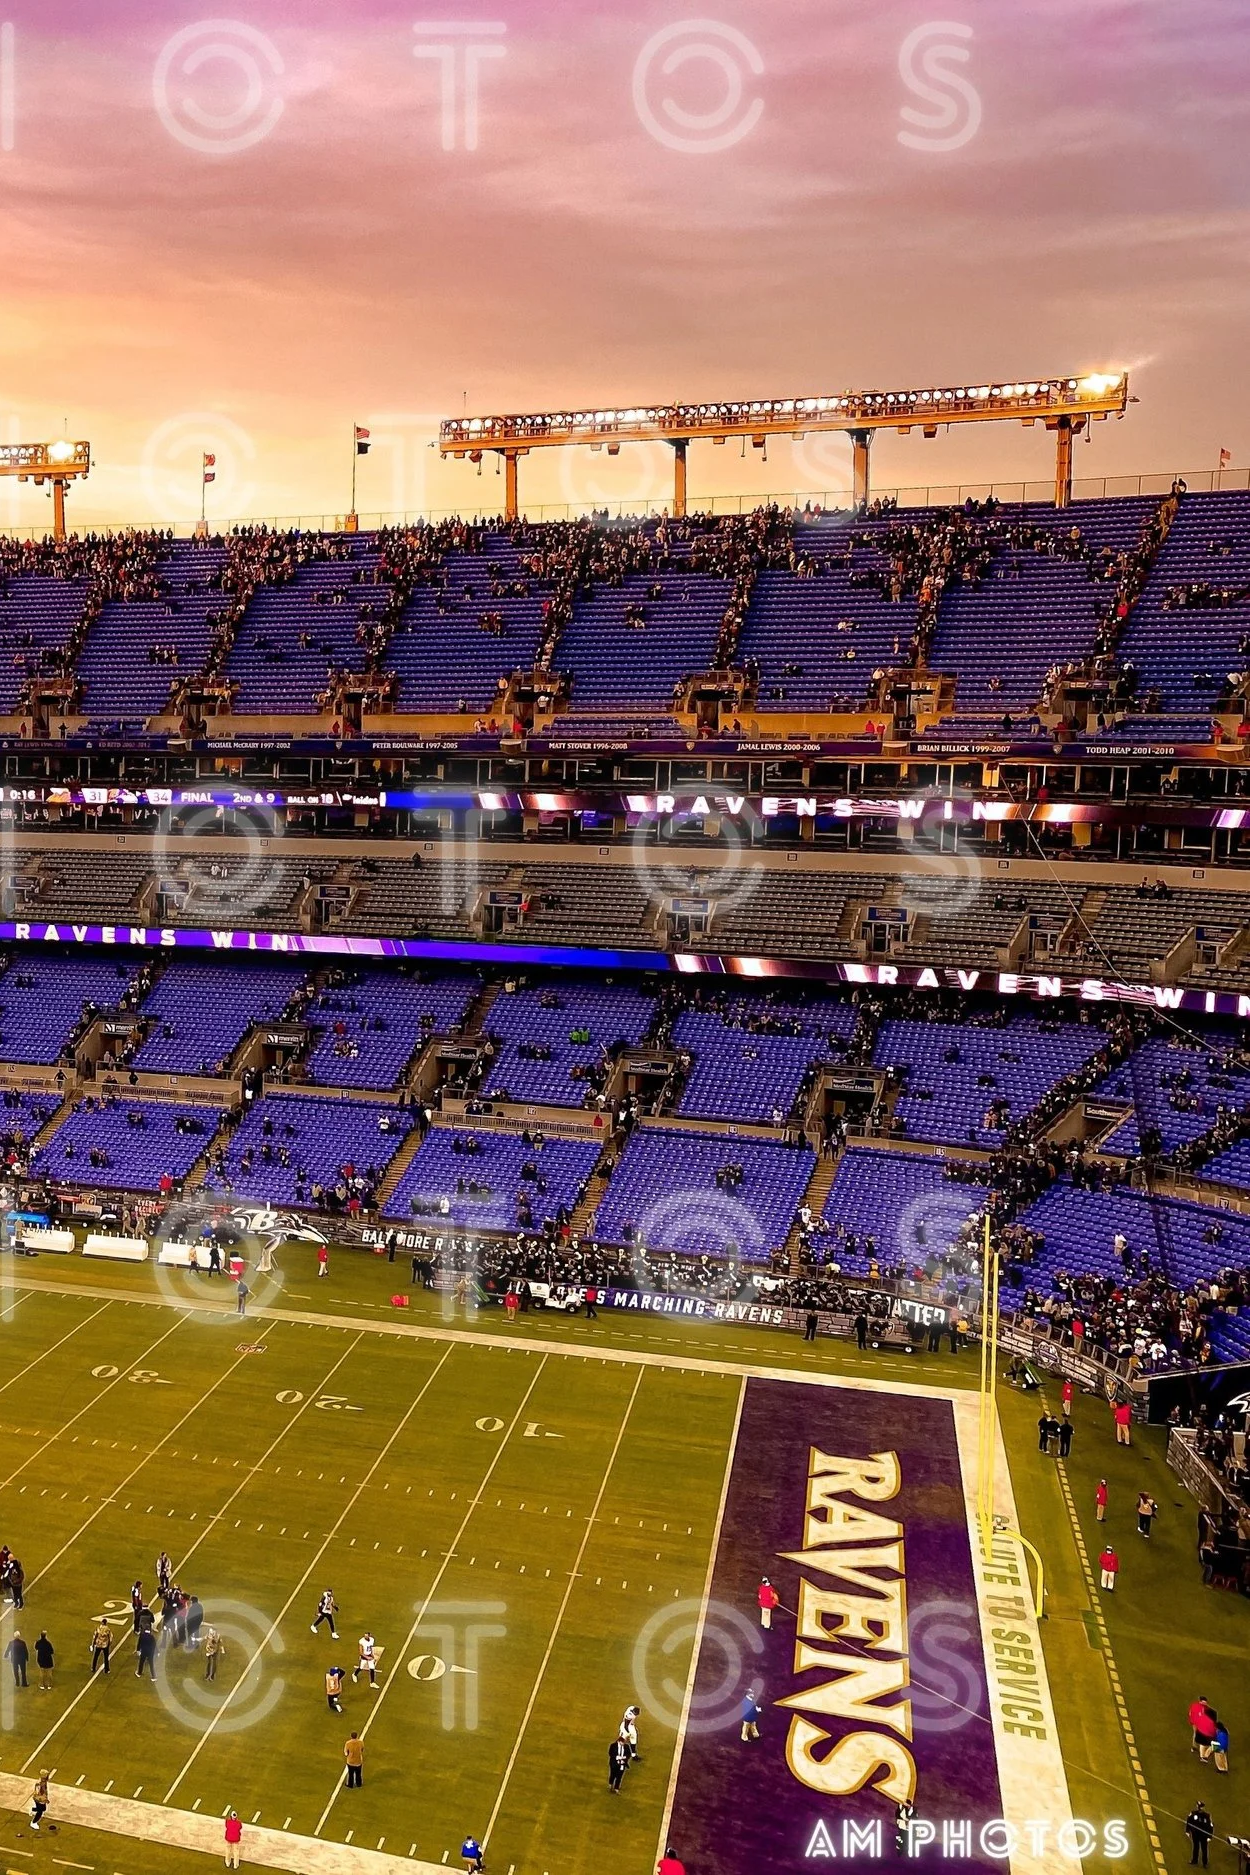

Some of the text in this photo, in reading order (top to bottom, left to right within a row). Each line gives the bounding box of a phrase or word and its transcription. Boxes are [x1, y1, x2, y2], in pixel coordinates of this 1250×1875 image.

[549, 742, 566, 750] MATT
[567, 742, 591, 750] STOVER
[737, 742, 759, 751] JAMAL
[760, 743, 781, 751] LEWIS
[917, 744, 1011, 753] BRIAN BILLICK 1999-2007
[1086, 746, 1108, 754] TODD
[1109, 746, 1131, 754] HEAP
[9, 789, 36, 801] 0:16
[89, 790, 102, 802] 31
[153, 791, 168, 803] 34
[181, 792, 214, 803] FINAL
[233, 793, 252, 803] 2ND
[254, 793, 263, 803] &
[266, 793, 275, 803] 9
[656, 795, 996, 821] RAVENS WIN
[15, 923, 290, 952] RAVENS WIN
[878, 966, 1105, 1002] RAVENS
[614, 1292, 705, 1315] MARCHING
[714, 1303, 784, 1325] RAVENS
[987, 1593, 1025, 1623] TO
[776, 1446, 918, 1803] RAVENS
[992, 1625, 1048, 1742] SERVICE
